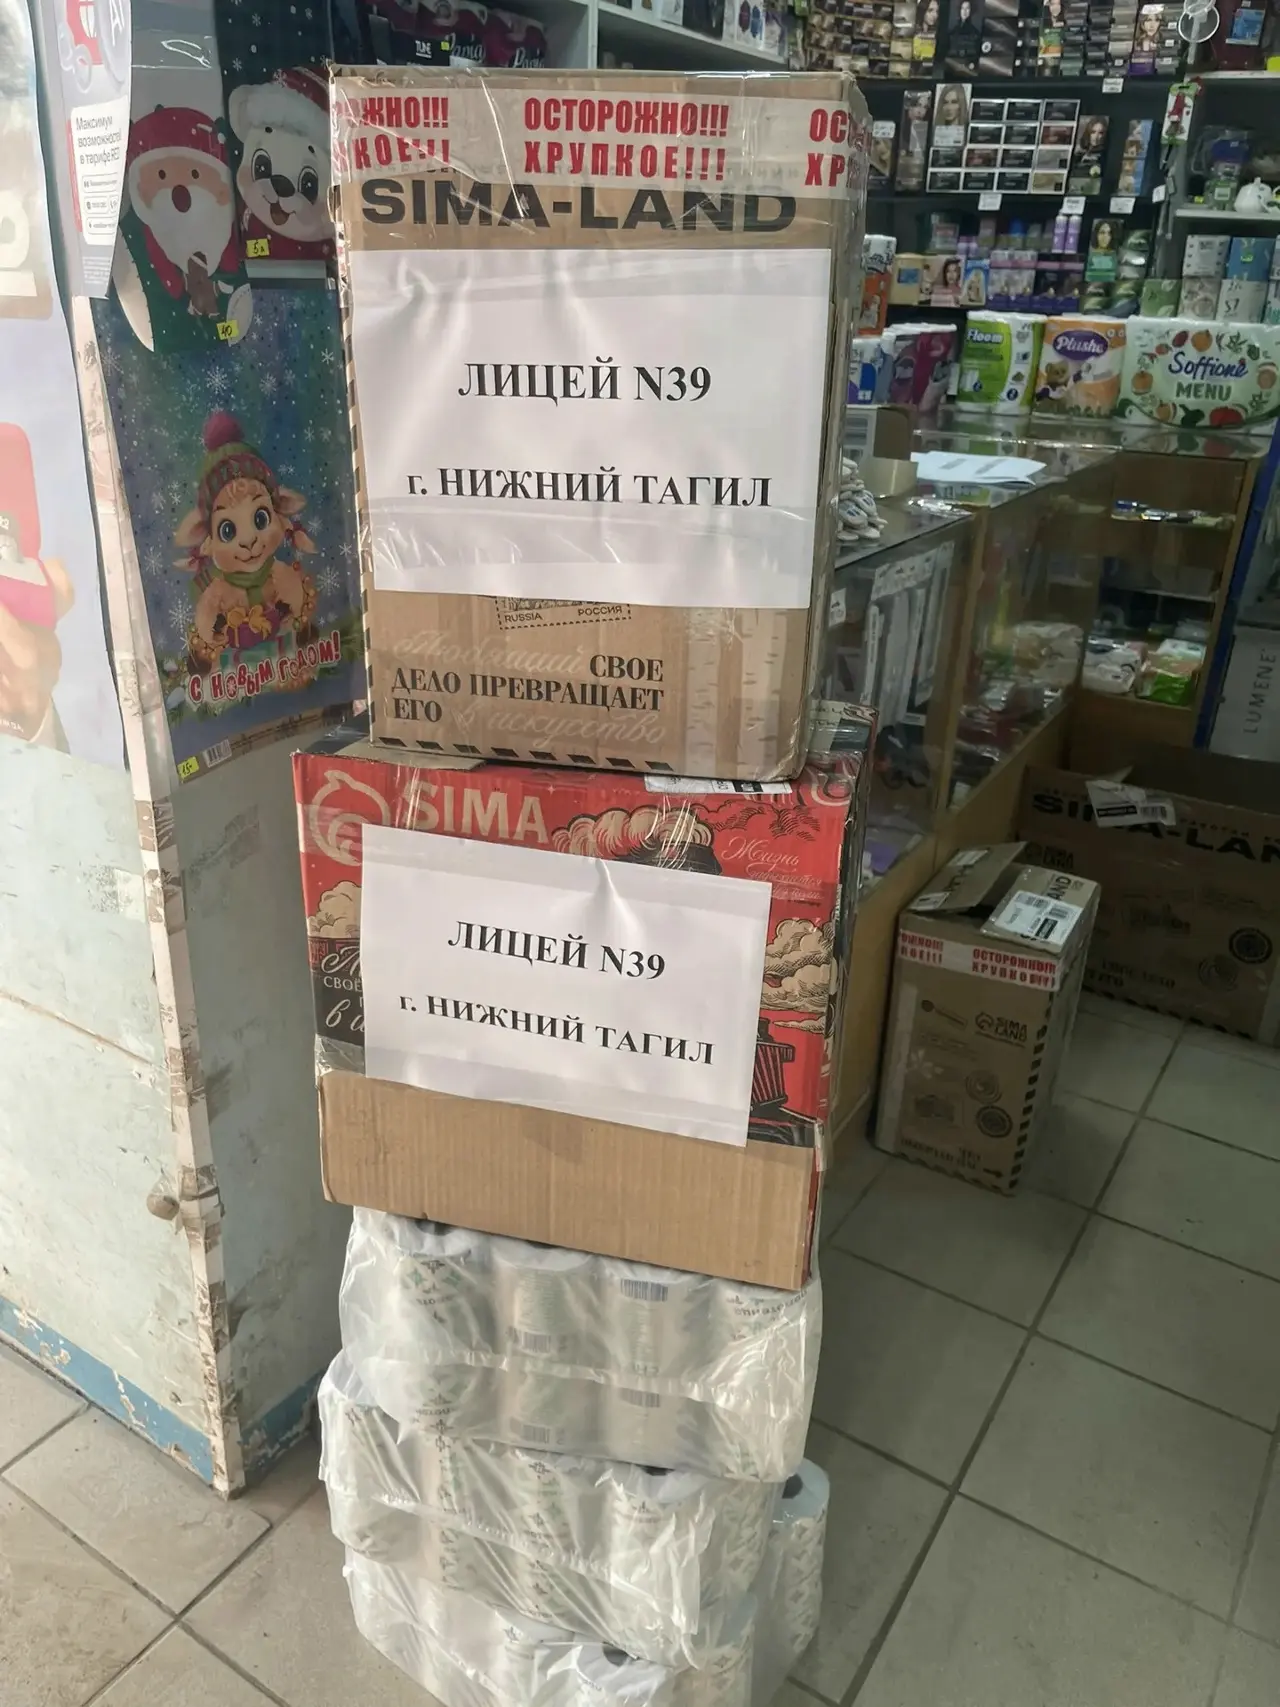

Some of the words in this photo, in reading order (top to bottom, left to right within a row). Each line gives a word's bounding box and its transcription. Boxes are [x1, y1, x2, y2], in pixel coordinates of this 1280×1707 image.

[524, 97, 729, 137] ОСТОРОЖНО!!!
[523, 141, 726, 181] ХРУПКОЕ!!!
[361, 178, 797, 233] SIMA-LAND
[966, 328, 1004, 344] Floom
[457, 355, 623, 407] ЛИЦЕЙ
[633, 365, 712, 402] N39
[1168, 351, 1249, 381] Soffione
[1175, 381, 1232, 401] MENU
[406, 474, 428, 496] г.
[437, 465, 623, 504] НИЖНИЙ
[633, 474, 773, 508] ТАГИЛ
[504, 612, 544, 623] RUSSIA
[577, 605, 623, 616] РОССИЯ
[589, 653, 664, 682] СВОЕ
[391, 666, 461, 695] ДЕЛО
[469, 672, 664, 712] ПРЕВРАЩАЕТ
[1243, 650, 1277, 735] LUMENE
[393, 697, 443, 723] ЕГО
[402, 780, 549, 845] SIMA
[721, 836, 800, 873] Жизнь
[447, 921, 589, 968] ЛИЦЕЙ
[599, 945, 666, 980] N39
[399, 995, 418, 1013] г.
[425, 994, 585, 1044] НИЖНИЙ
[594, 1025, 717, 1066] ТАГИЛ
